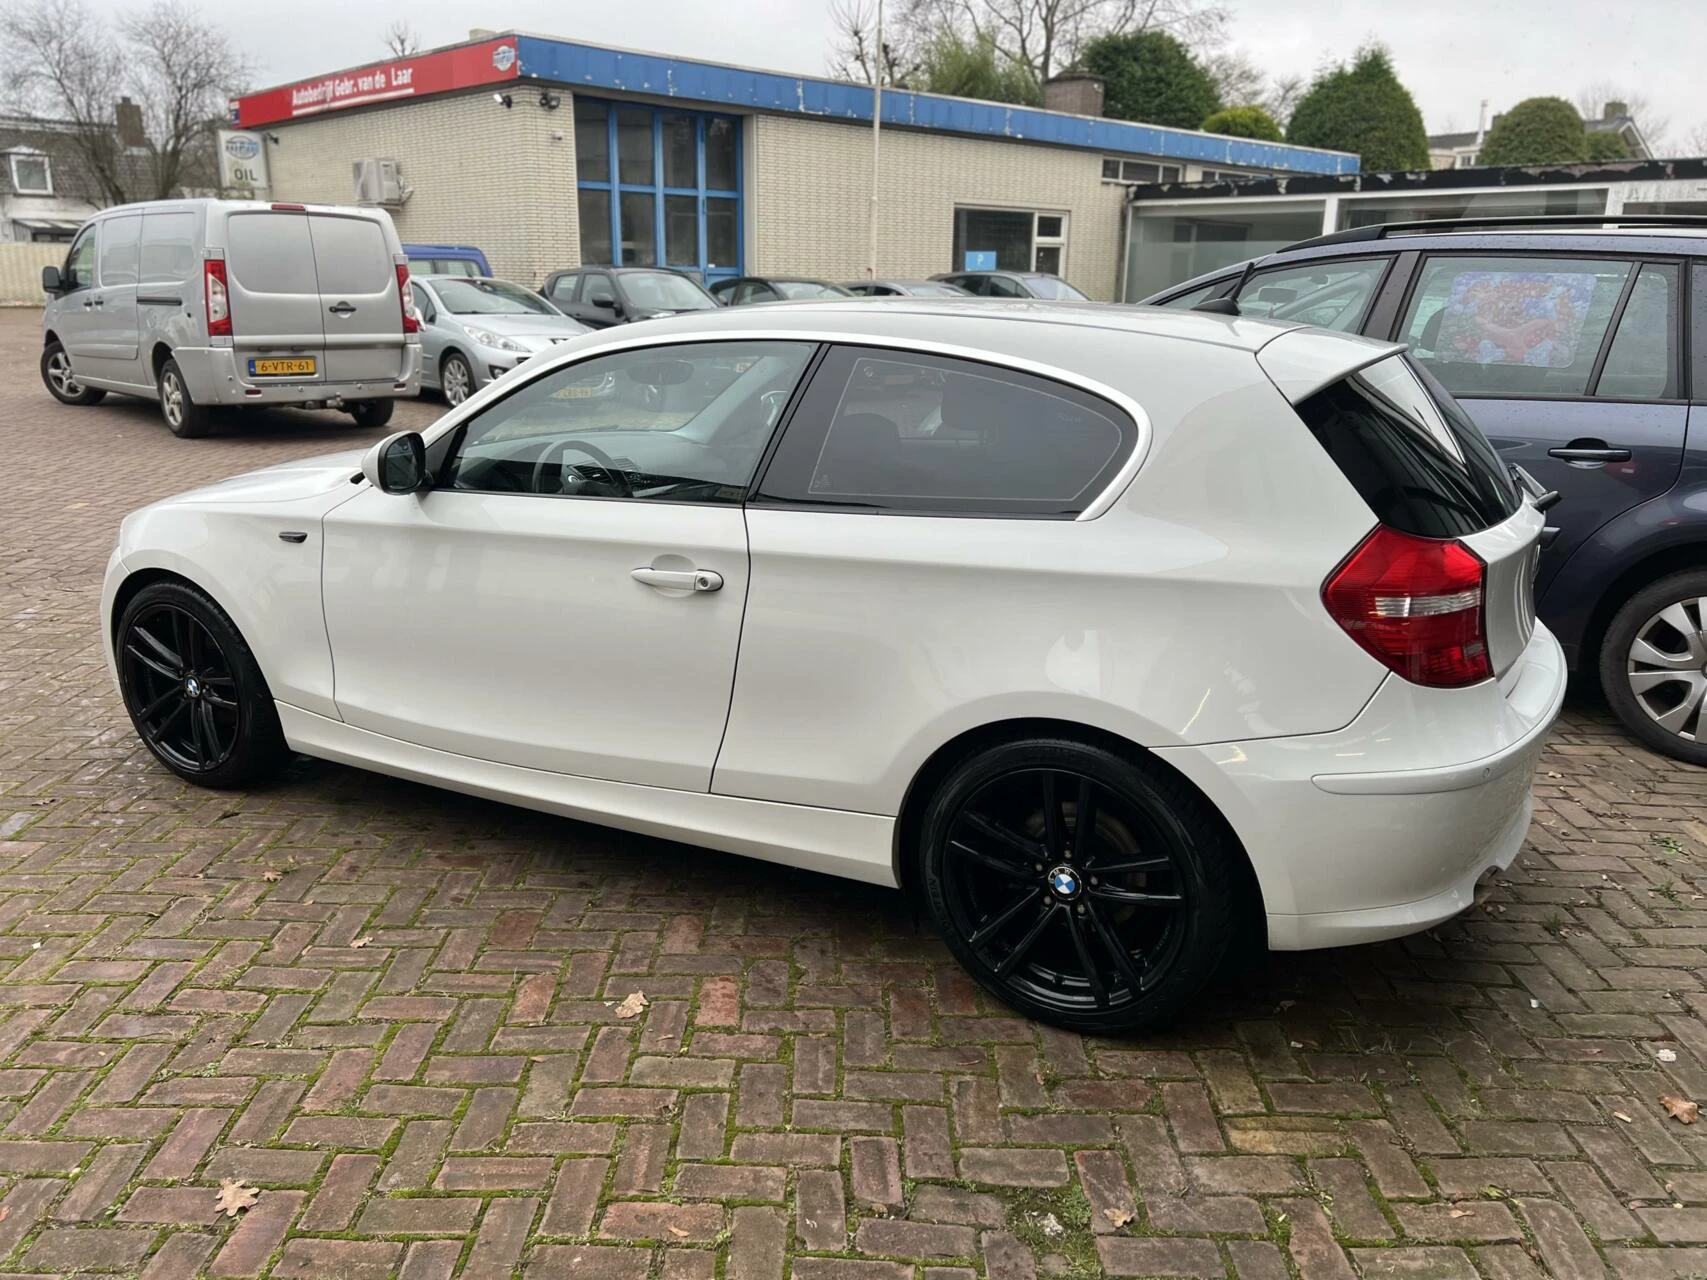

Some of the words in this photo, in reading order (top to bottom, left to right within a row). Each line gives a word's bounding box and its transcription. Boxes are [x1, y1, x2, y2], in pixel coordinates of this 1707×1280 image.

[334, 77, 357, 97] Gebr.
[357, 75, 374, 91] van
[374, 70, 386, 89] de
[391, 67, 413, 86] Laar
[234, 168, 259, 181] OIL
[260, 361, 310, 372] 6-VTR-61
